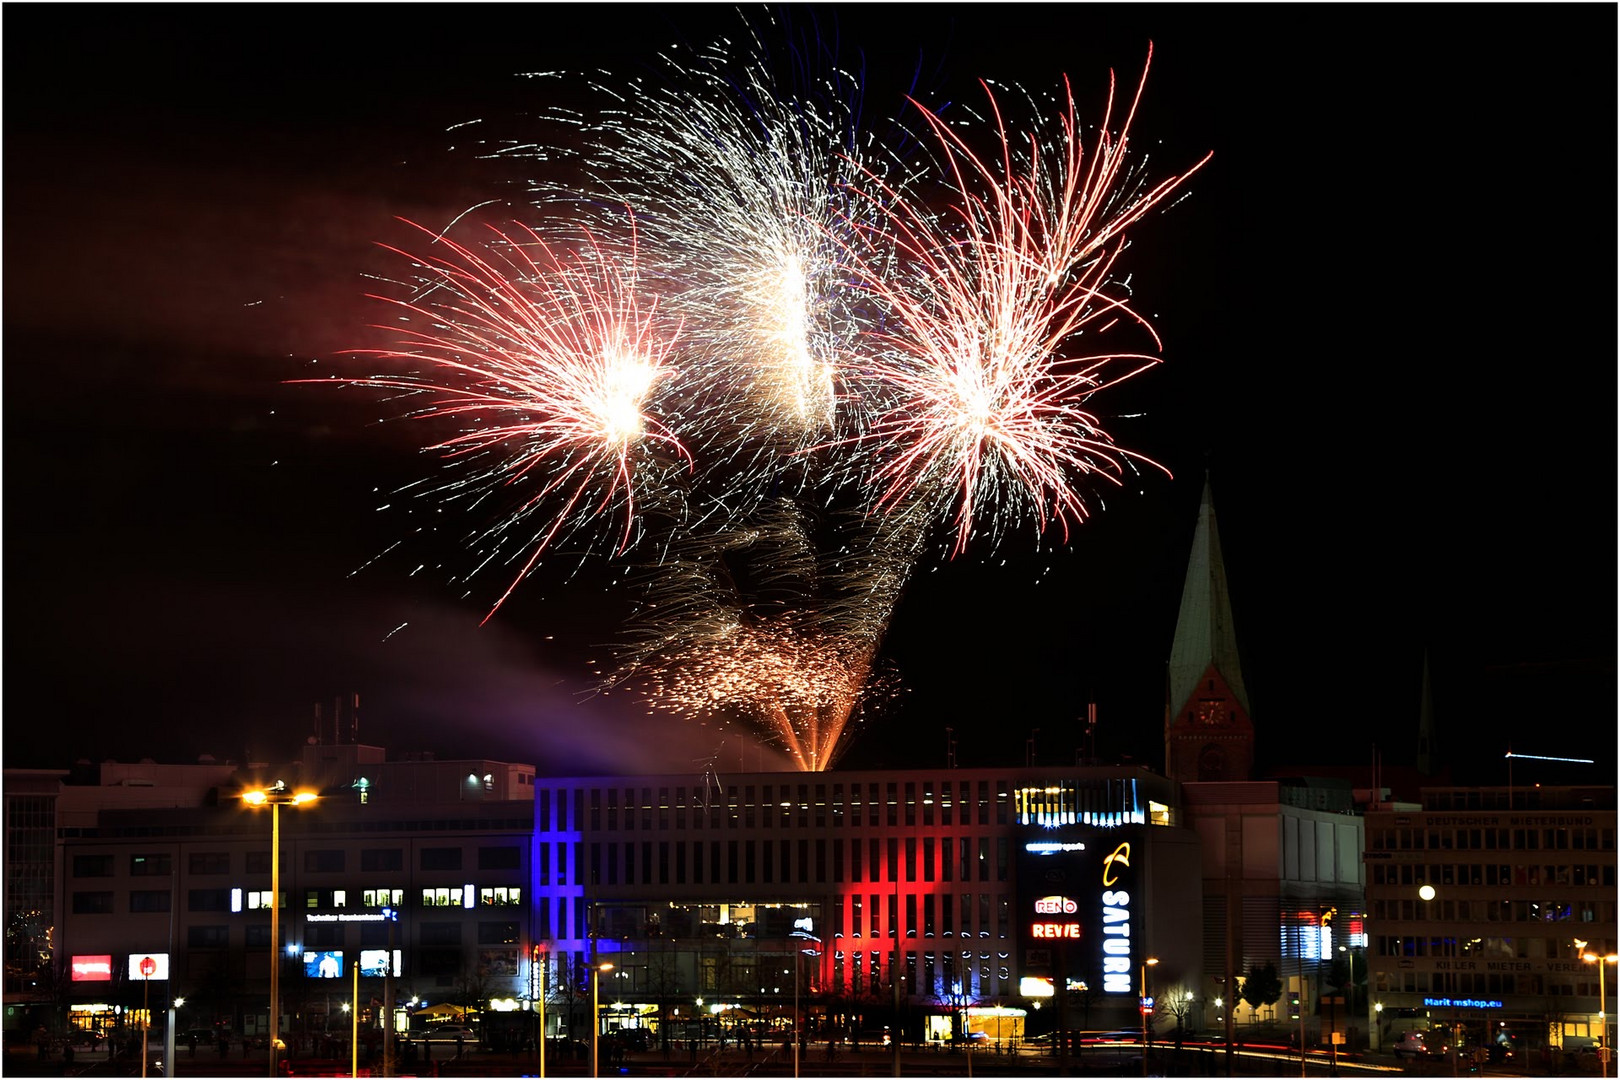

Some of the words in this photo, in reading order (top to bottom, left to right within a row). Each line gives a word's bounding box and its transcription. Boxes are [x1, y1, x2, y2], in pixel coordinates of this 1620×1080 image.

[1426, 816, 1499, 826] DEUTSCHER
[1510, 816, 1593, 826] MIETERBUND
[1036, 901, 1077, 913] RENO
[1032, 924, 1080, 938] REWE
[1102, 890, 1131, 993] SATURN
[1487, 961, 1531, 971] MIETER
[1424, 998, 1502, 1008] Maritmshop.eu
